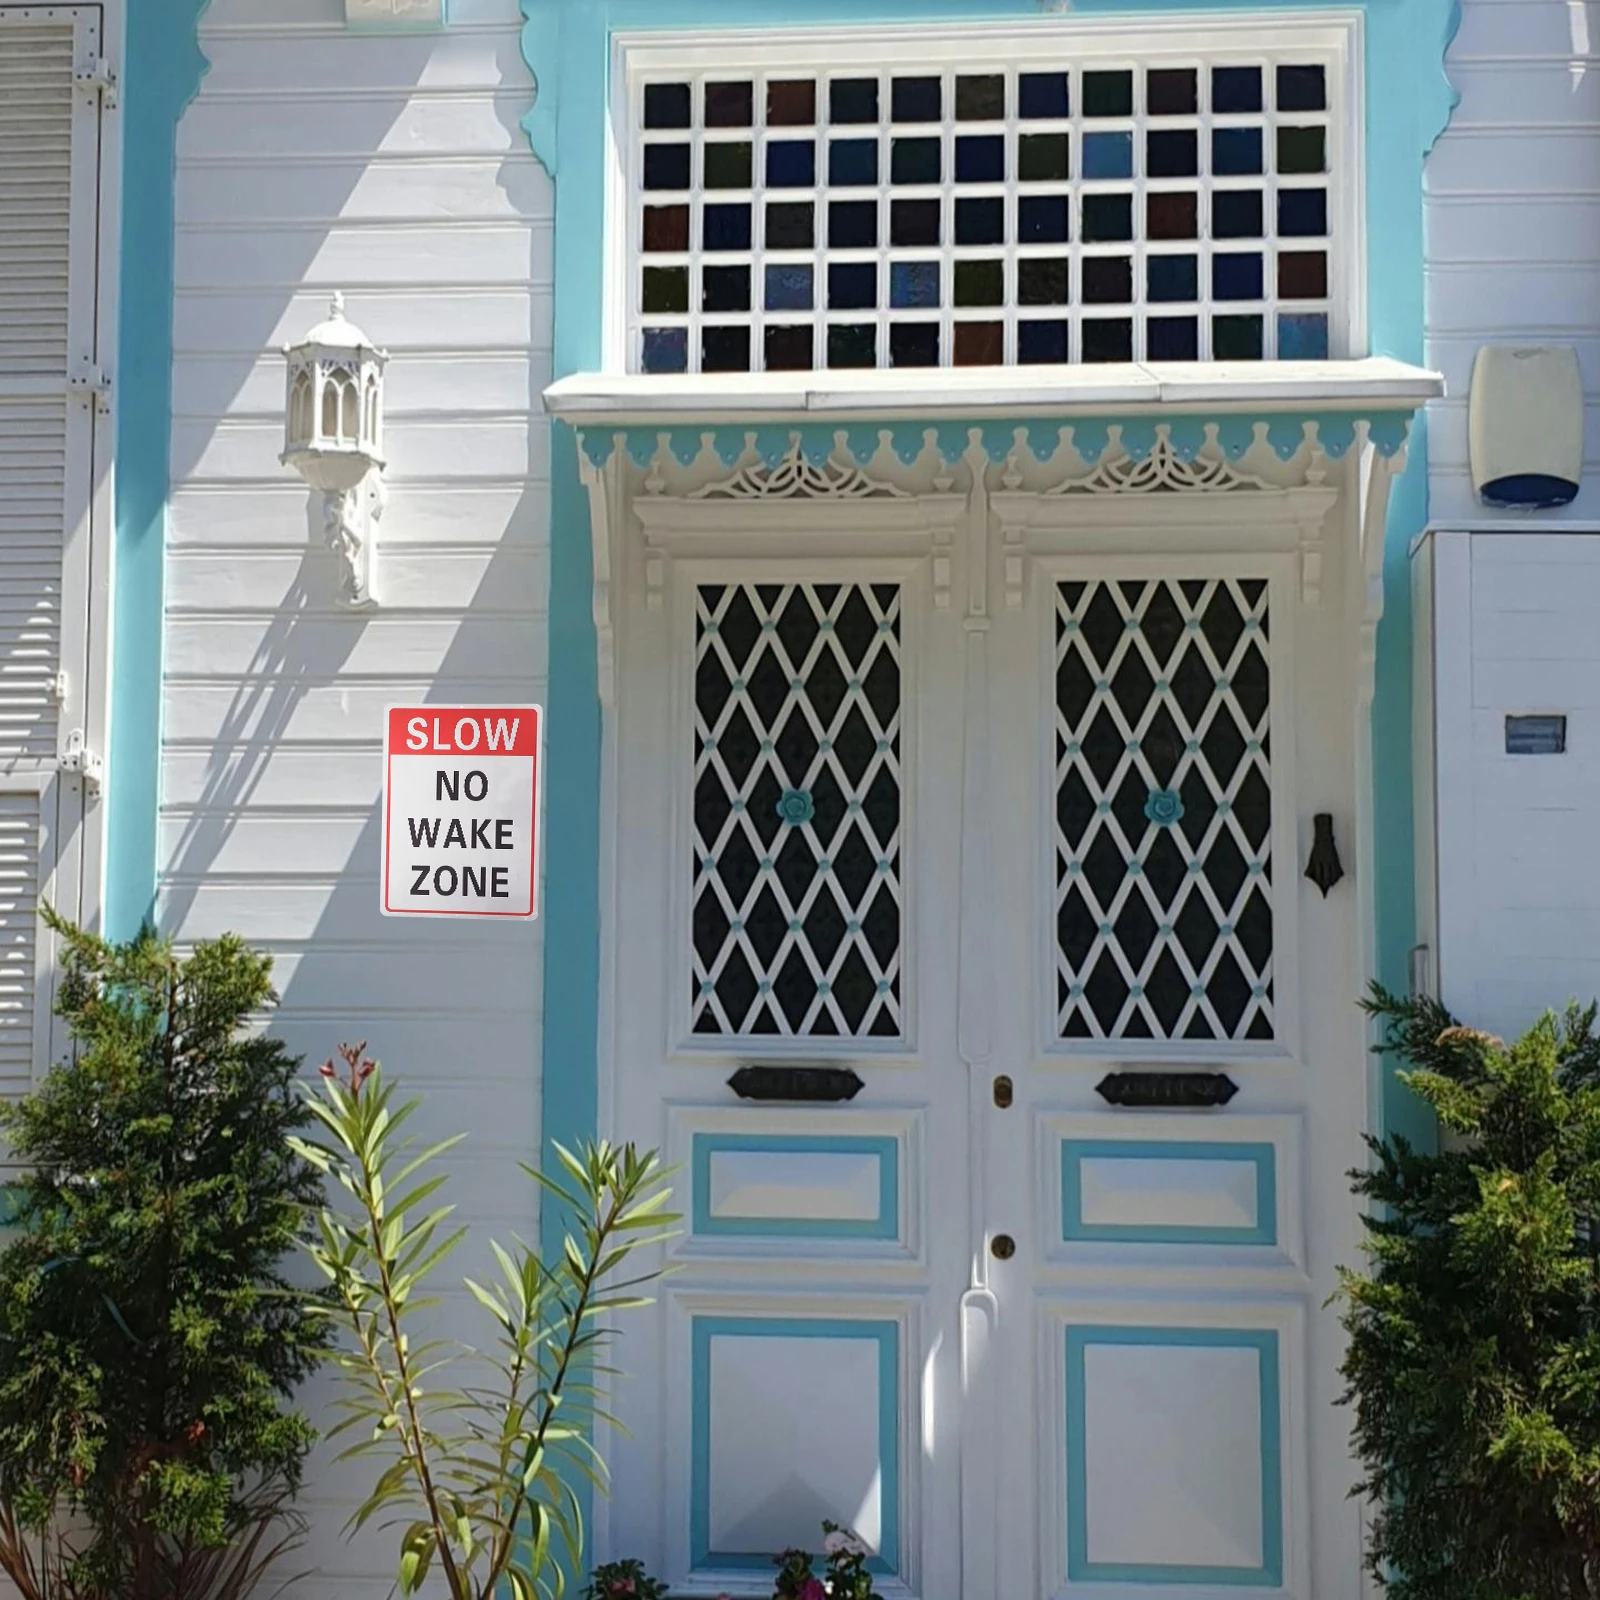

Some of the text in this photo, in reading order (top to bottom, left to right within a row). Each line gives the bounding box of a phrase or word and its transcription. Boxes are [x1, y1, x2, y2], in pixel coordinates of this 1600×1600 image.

[406, 717, 520, 750] SLOW
[436, 770, 489, 801] NO
[408, 818, 514, 849] WAKE
[410, 865, 509, 897] ZONE
